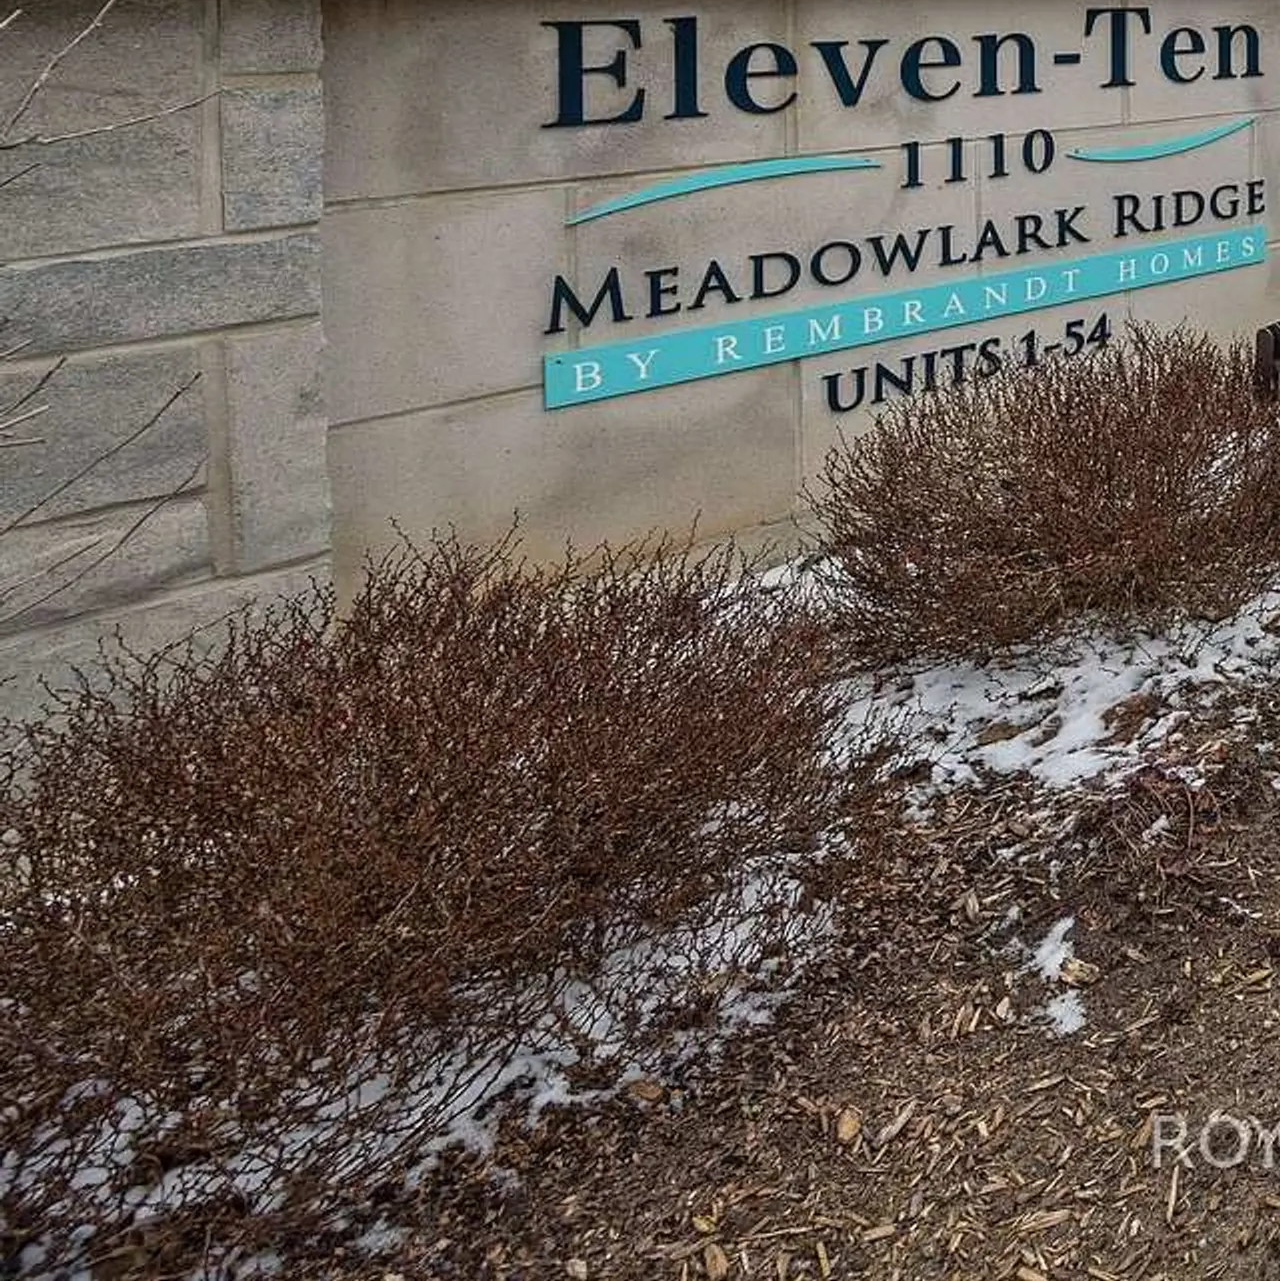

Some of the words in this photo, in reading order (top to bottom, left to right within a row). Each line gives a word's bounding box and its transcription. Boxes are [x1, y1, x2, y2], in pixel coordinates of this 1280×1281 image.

[540, 6, 1265, 130] Eleven-Ten
[899, 128, 1056, 189] 1110
[543, 205, 1088, 335] MEADOWLARK
[1113, 179, 1266, 239] RIDGE
[573, 349, 657, 393] BY
[714, 268, 1082, 363] REMBRANDT
[1118, 234, 1257, 280] HOMES
[822, 337, 1000, 413] UNITS
[1018, 312, 1111, 368] 1-54
